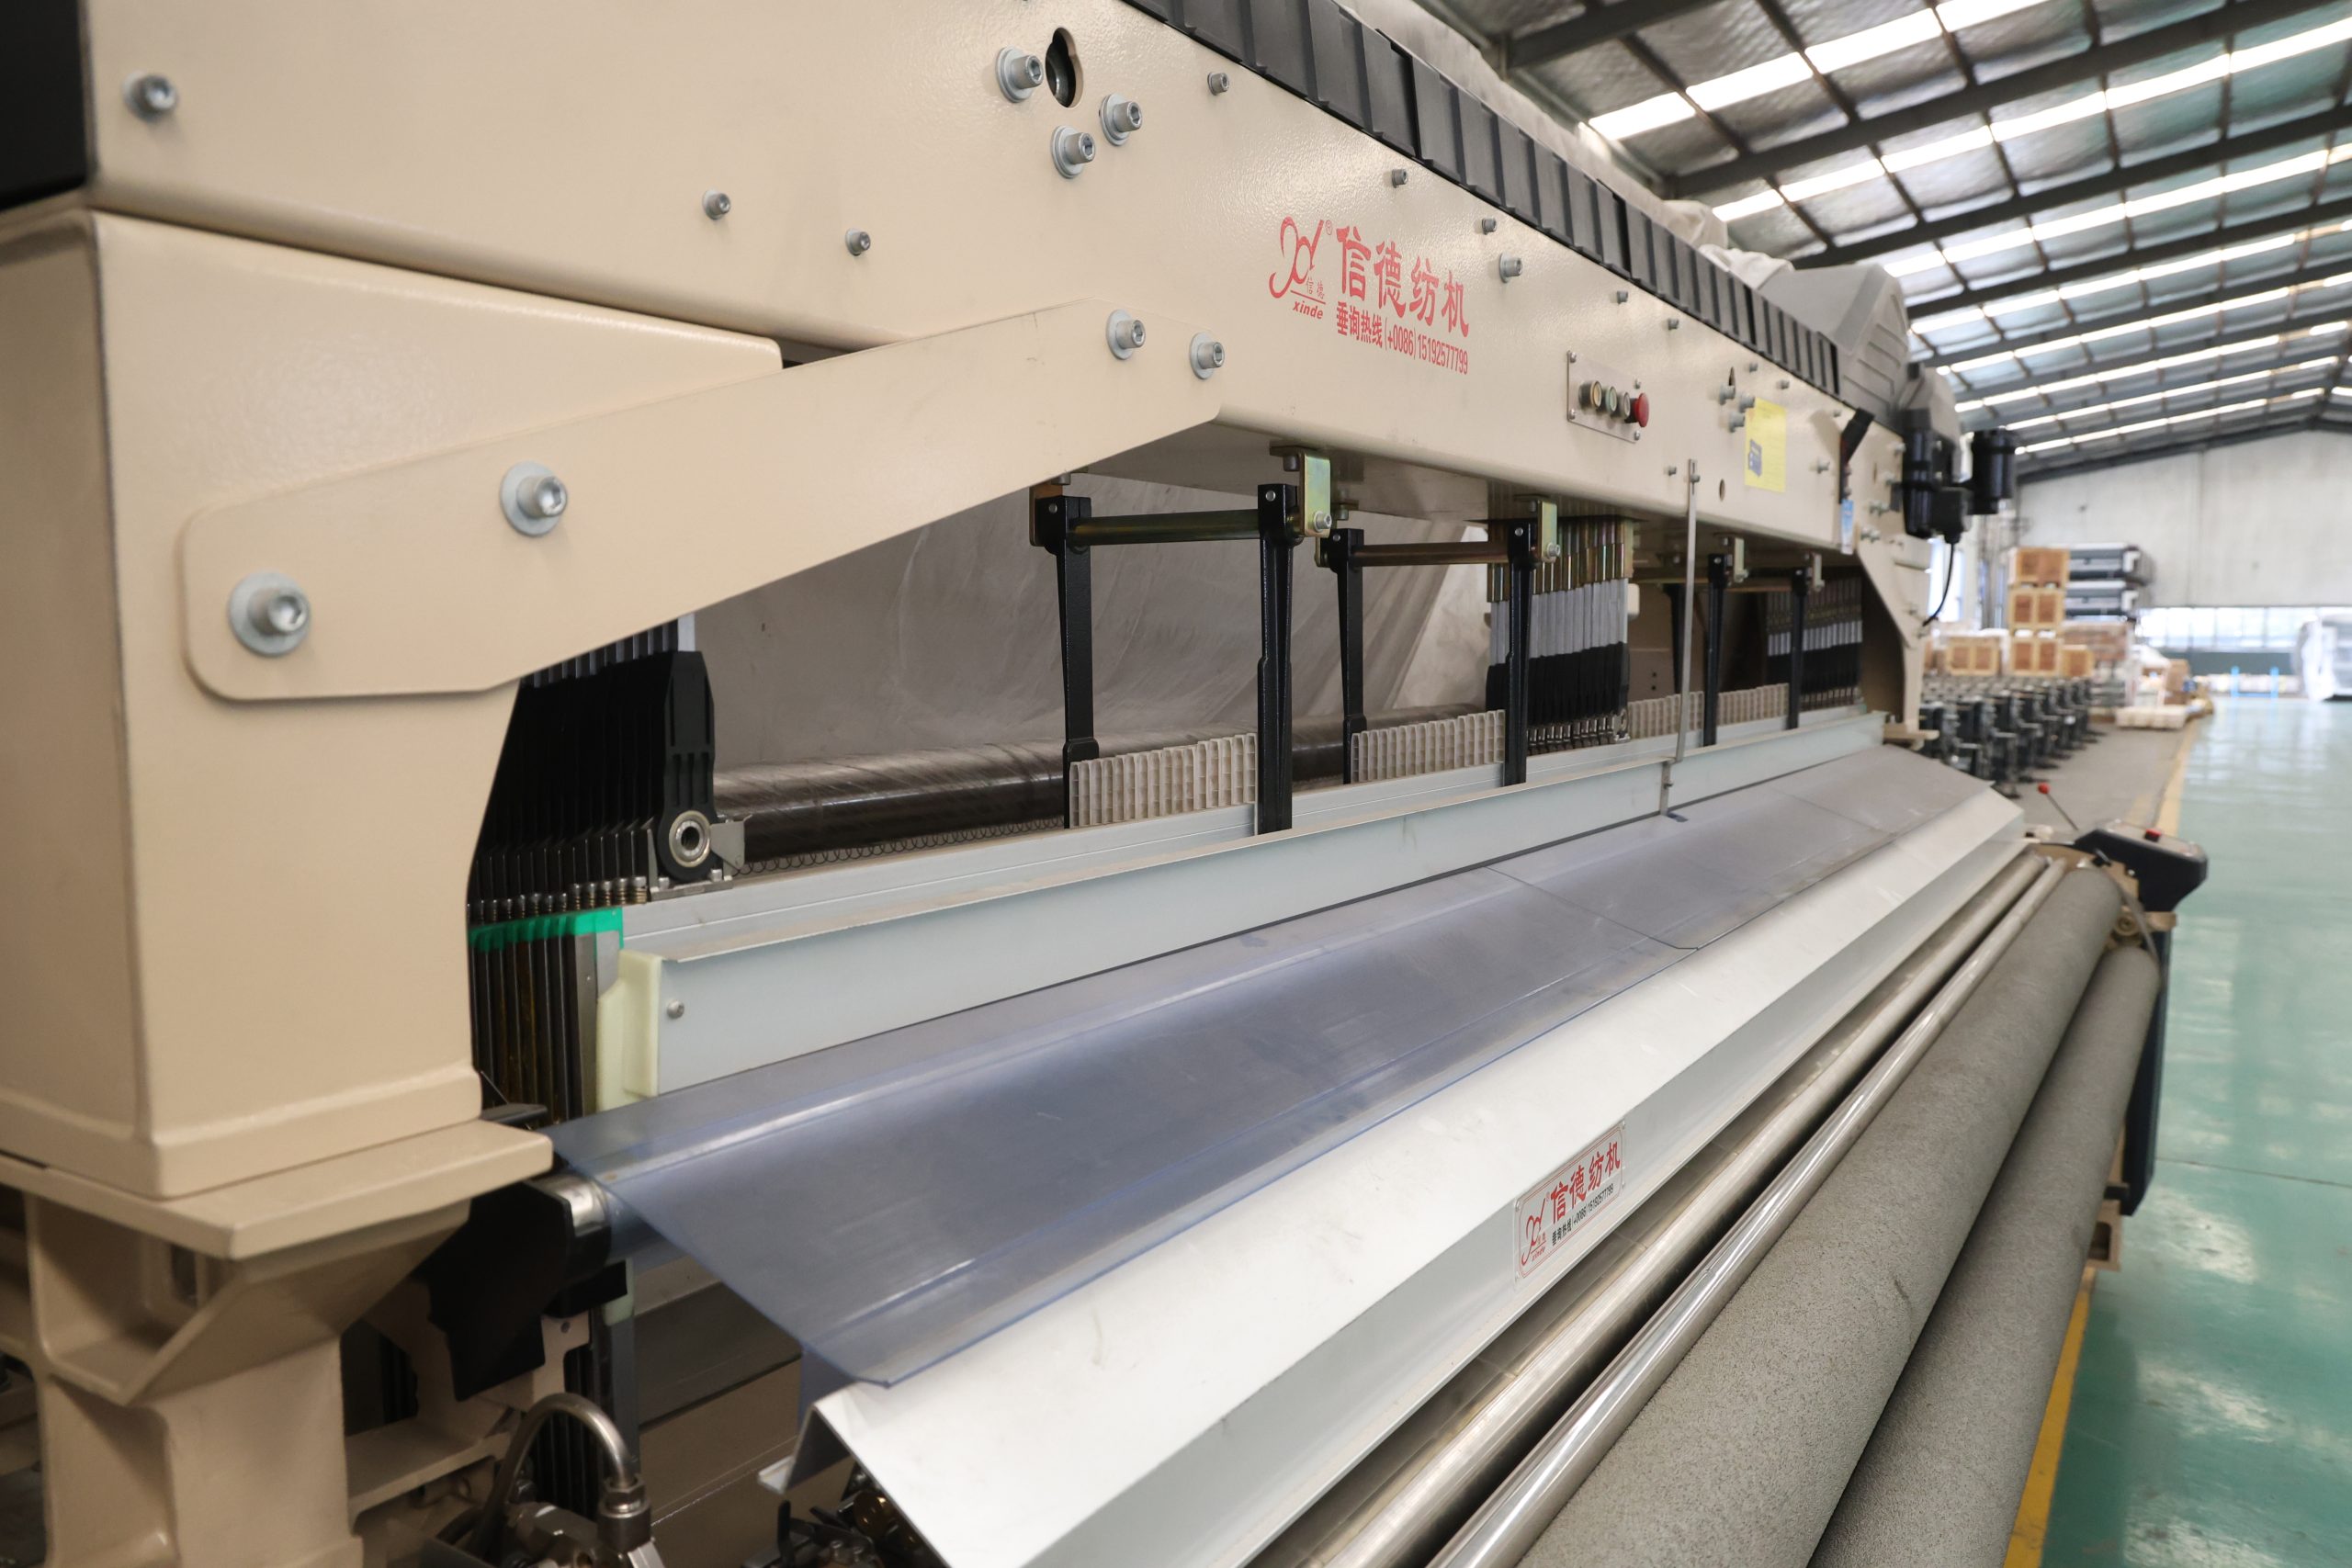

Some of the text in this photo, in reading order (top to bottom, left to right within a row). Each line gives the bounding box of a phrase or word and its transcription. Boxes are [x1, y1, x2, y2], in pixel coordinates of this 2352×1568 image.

[1293, 300, 1324, 320] xinde
[1336, 226, 1468, 337] 信德纺机
[1551, 1141, 1620, 1224] 信德纺机
